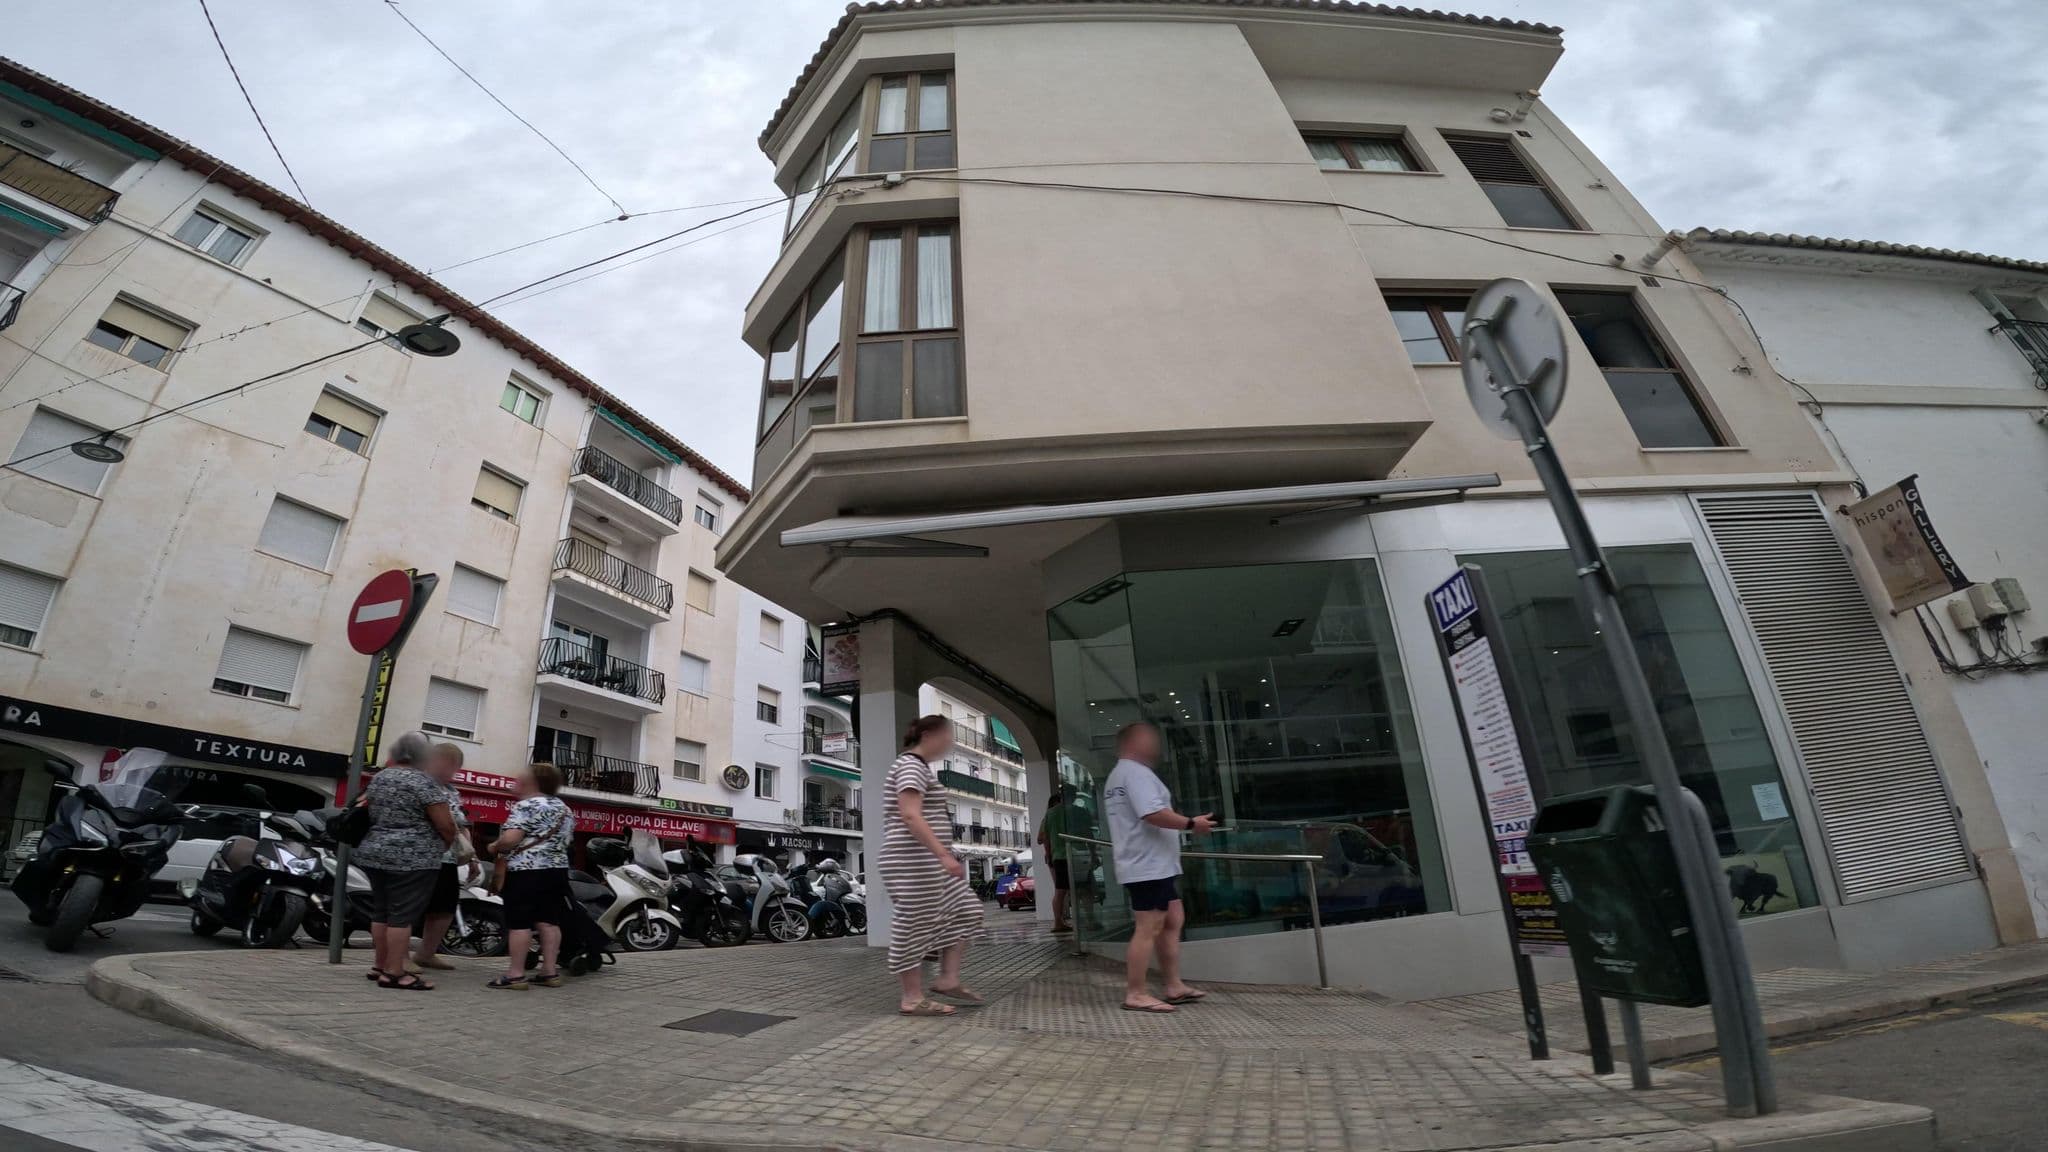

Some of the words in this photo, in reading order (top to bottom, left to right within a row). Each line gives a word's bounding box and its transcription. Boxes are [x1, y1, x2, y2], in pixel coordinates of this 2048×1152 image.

[1854, 498, 1904, 527] hispan
[1905, 488, 1958, 579] GALLERY
[1434, 575, 1473, 622] TAXI
[195, 738, 306, 767] TEXTURA
[617, 813, 651, 827] COPIA
[654, 817, 668, 829] DE
[1493, 820, 1529, 834] TAXI
[781, 836, 812, 849] MACSON
